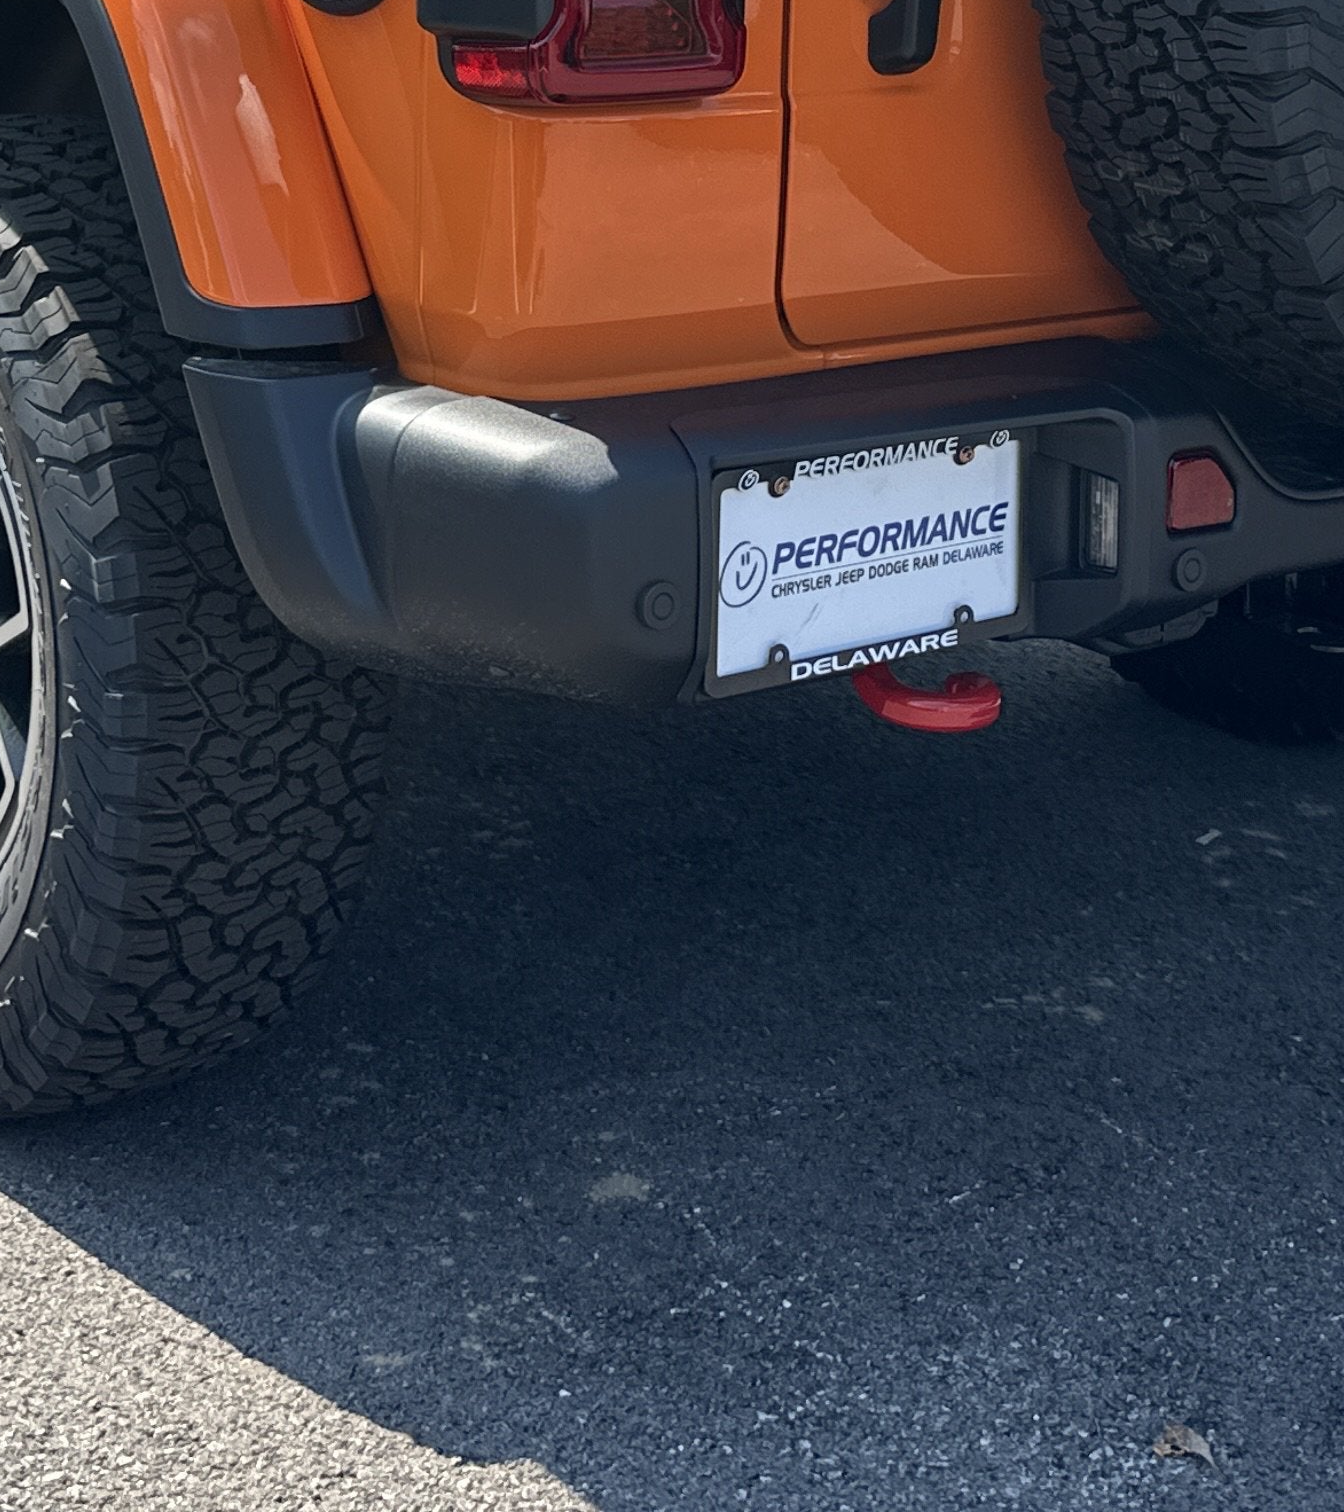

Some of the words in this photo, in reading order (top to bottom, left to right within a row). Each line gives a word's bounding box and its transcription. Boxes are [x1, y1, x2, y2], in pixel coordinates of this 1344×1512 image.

[794, 436, 960, 479] PERFORMANCE
[772, 502, 1009, 574] PERFORMANCE
[771, 574, 832, 599] CHRYSLER
[835, 568, 864, 588] JEEP
[868, 560, 909, 582] DODGE
[912, 554, 939, 574] RAM
[942, 540, 1004, 566] DELAWARE
[790, 628, 959, 681] DELAWARE
